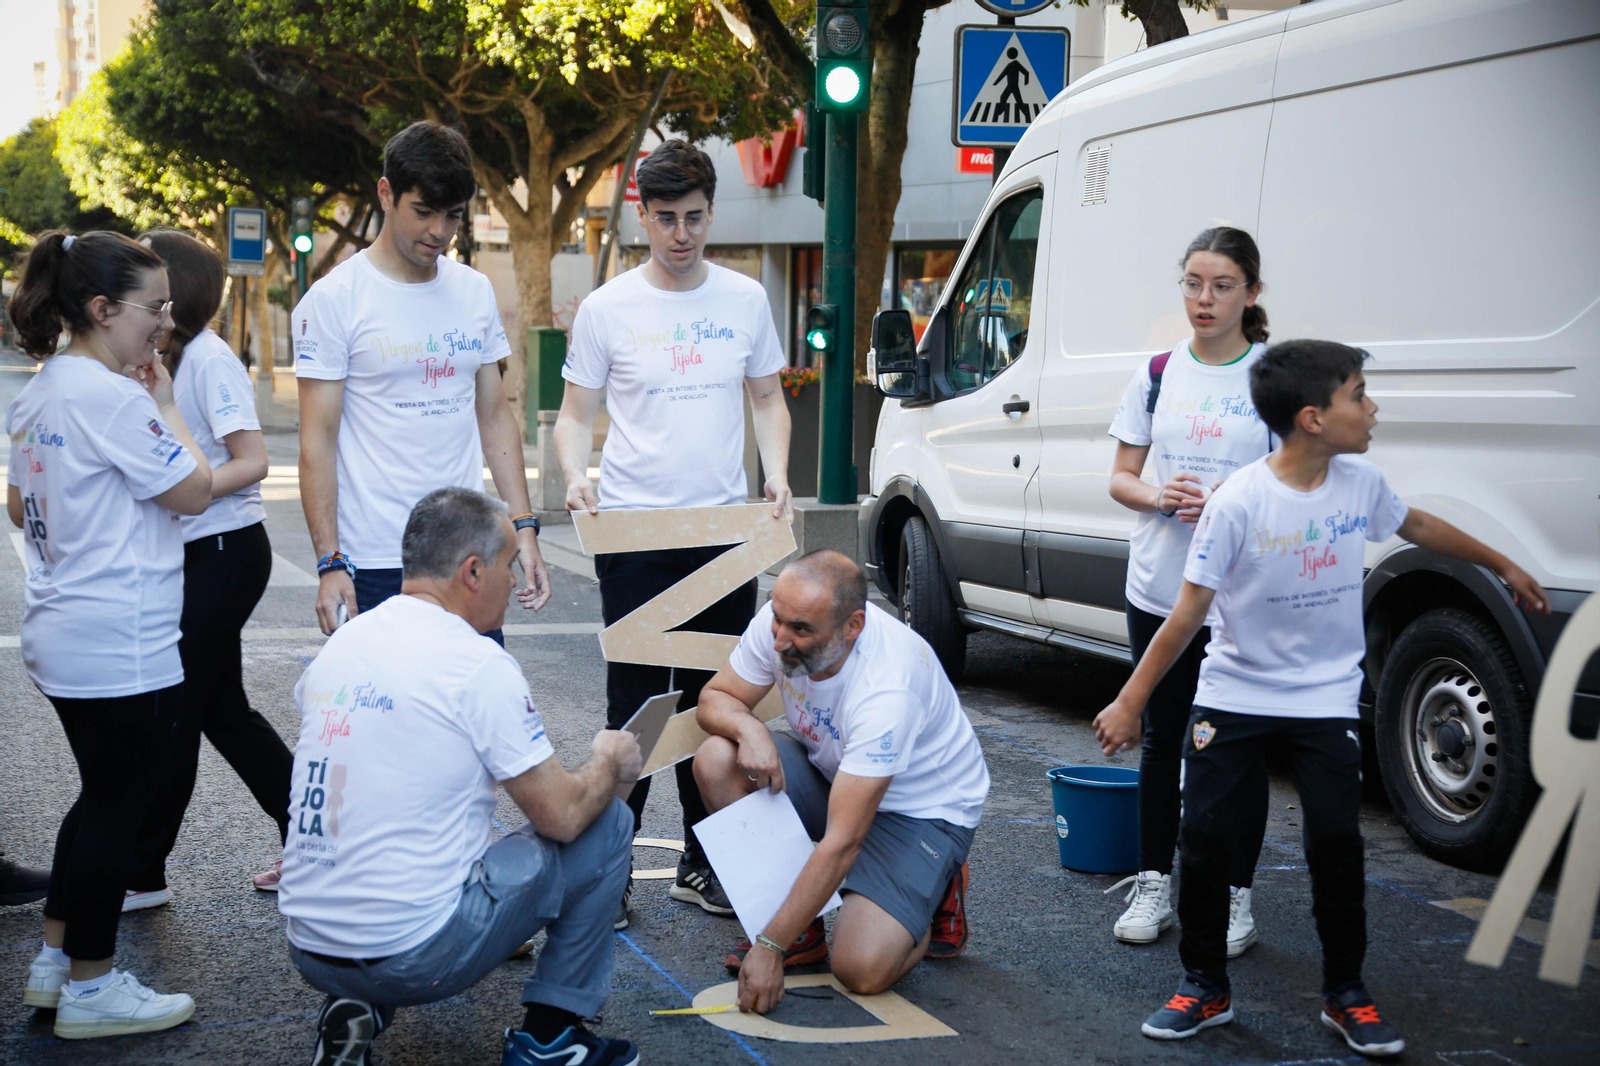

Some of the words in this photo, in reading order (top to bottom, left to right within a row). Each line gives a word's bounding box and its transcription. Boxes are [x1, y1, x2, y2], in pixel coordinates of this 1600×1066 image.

[426, 333, 441, 353] de
[673, 322, 687, 342] de
[691, 317, 734, 345] Fátima
[1199, 395, 1215, 412] de
[1219, 394, 1259, 421] Fátim
[1305, 519, 1320, 542] de
[334, 684, 348, 705] de
[308, 757, 328, 785] TÍ
[300, 786, 325, 811] JO
[298, 811, 324, 837] LA
